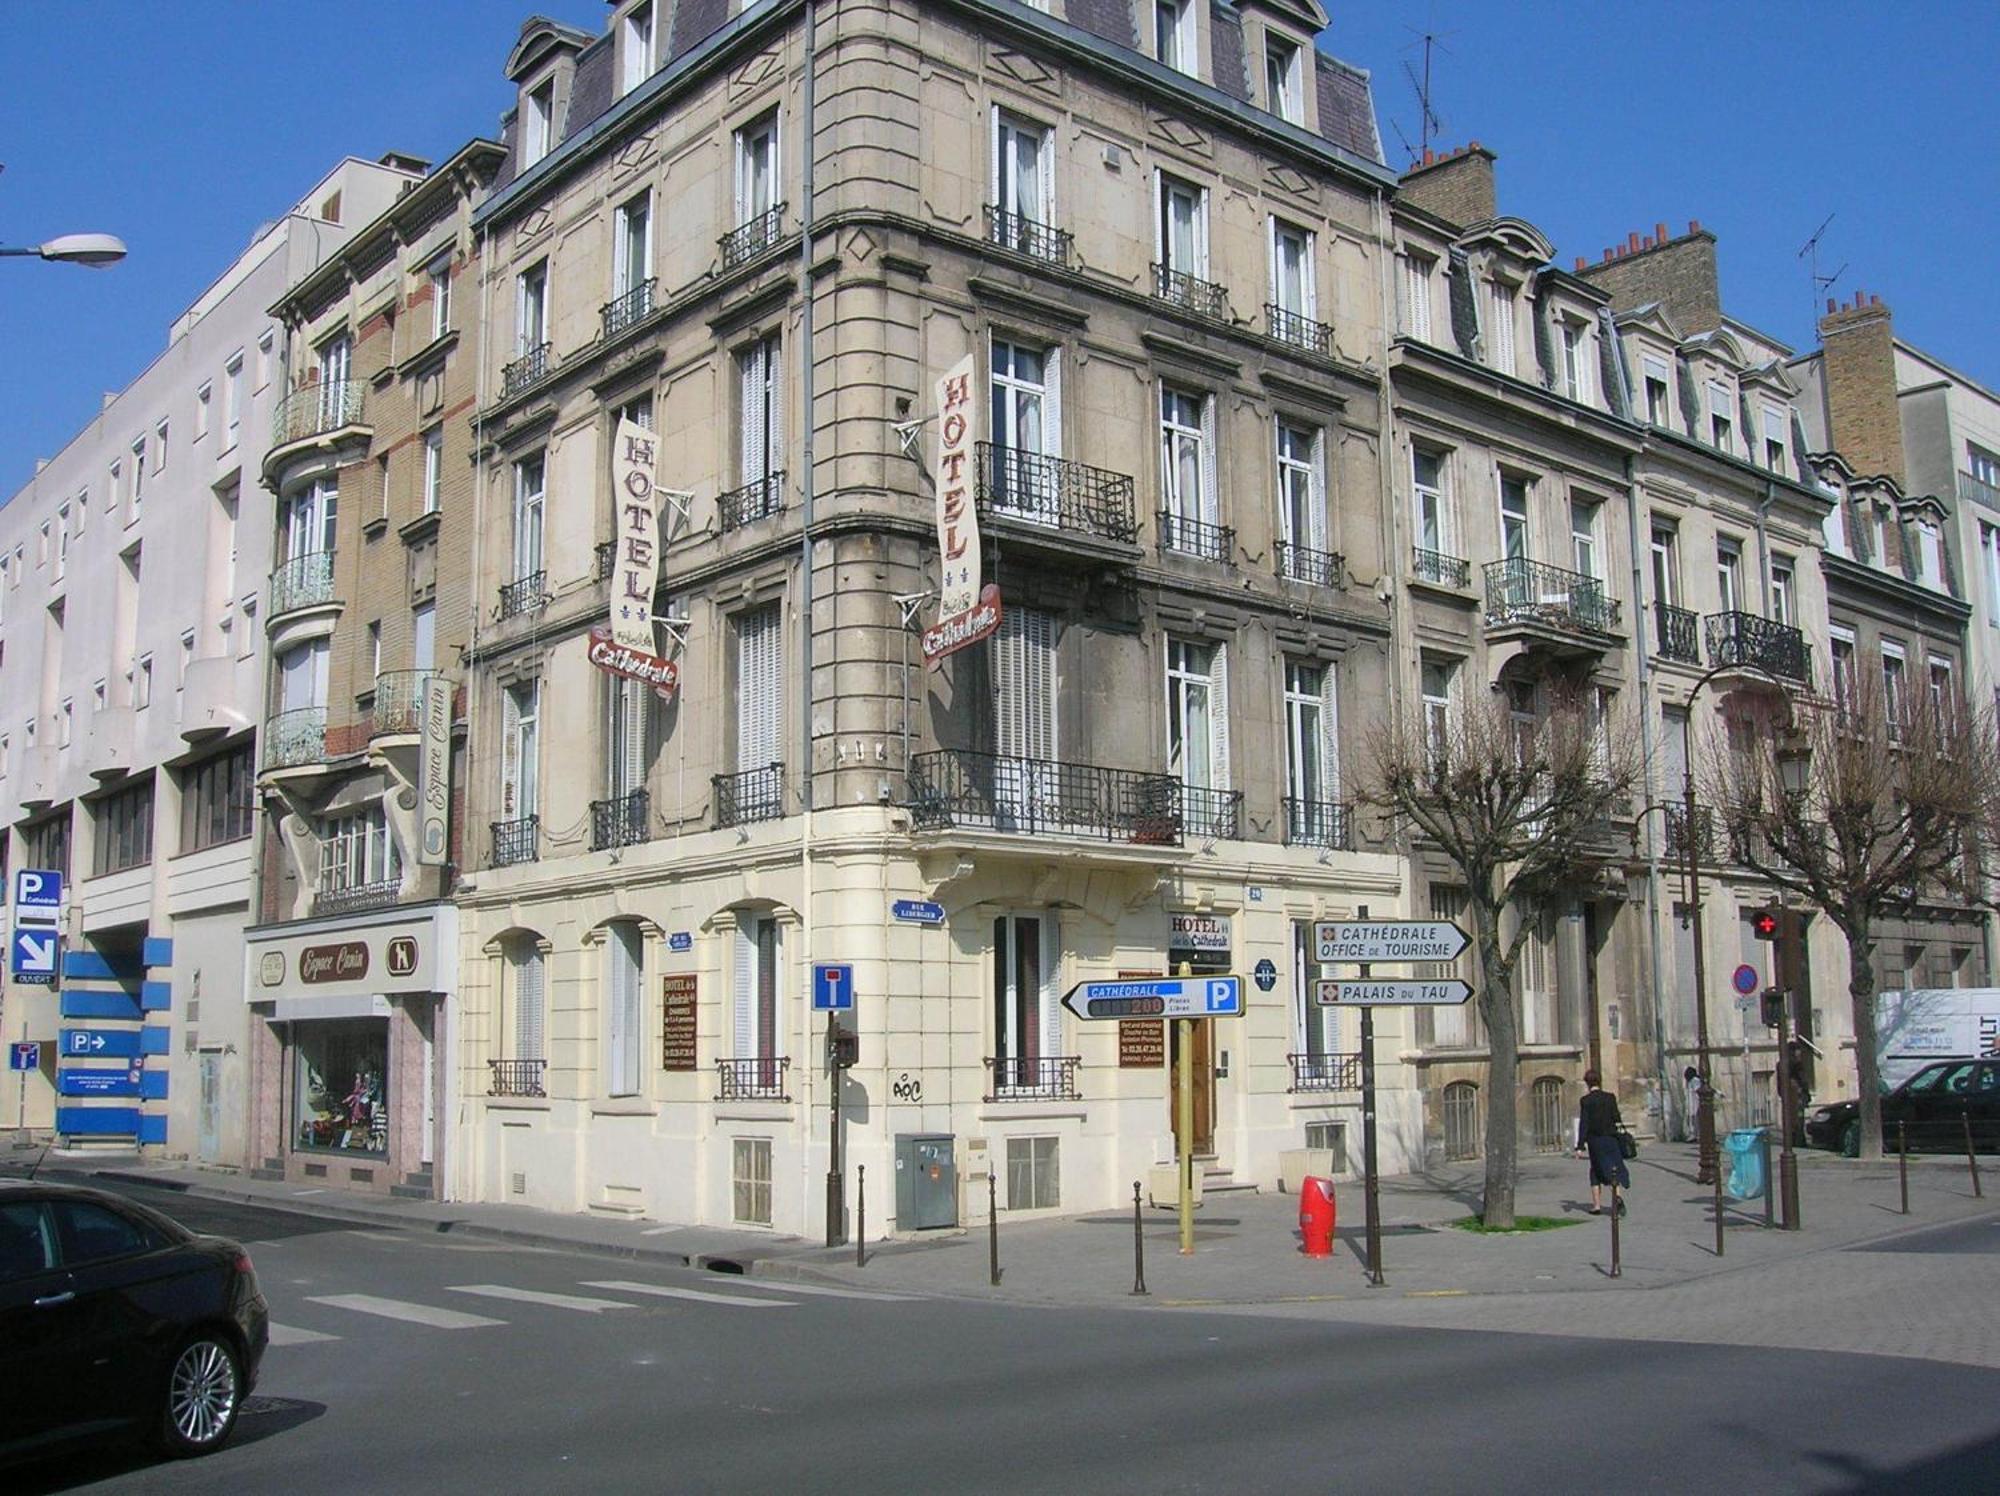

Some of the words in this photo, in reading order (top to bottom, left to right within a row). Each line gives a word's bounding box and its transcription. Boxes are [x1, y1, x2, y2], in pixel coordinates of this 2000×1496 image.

[942, 373, 970, 561] HOTEL
[624, 435, 655, 602] HOTEL
[428, 688, 448, 743] Canin
[426, 748, 448, 811] Espace
[19, 873, 43, 903] P
[1172, 917, 1220, 933] HOTEL
[1342, 926, 1437, 940] CATHÉDRALE
[303, 950, 333, 980] Espace
[337, 946, 364, 974] Canin
[1321, 944, 1364, 957] OFFICE
[1385, 943, 1450, 956] TOURISME
[1091, 985, 1159, 997] CATHÉDRALE
[1212, 982, 1231, 1009] P
[1343, 986, 1395, 999] PALAIS
[1421, 986, 1448, 999] TAU
[75, 1035, 87, 1049] P
